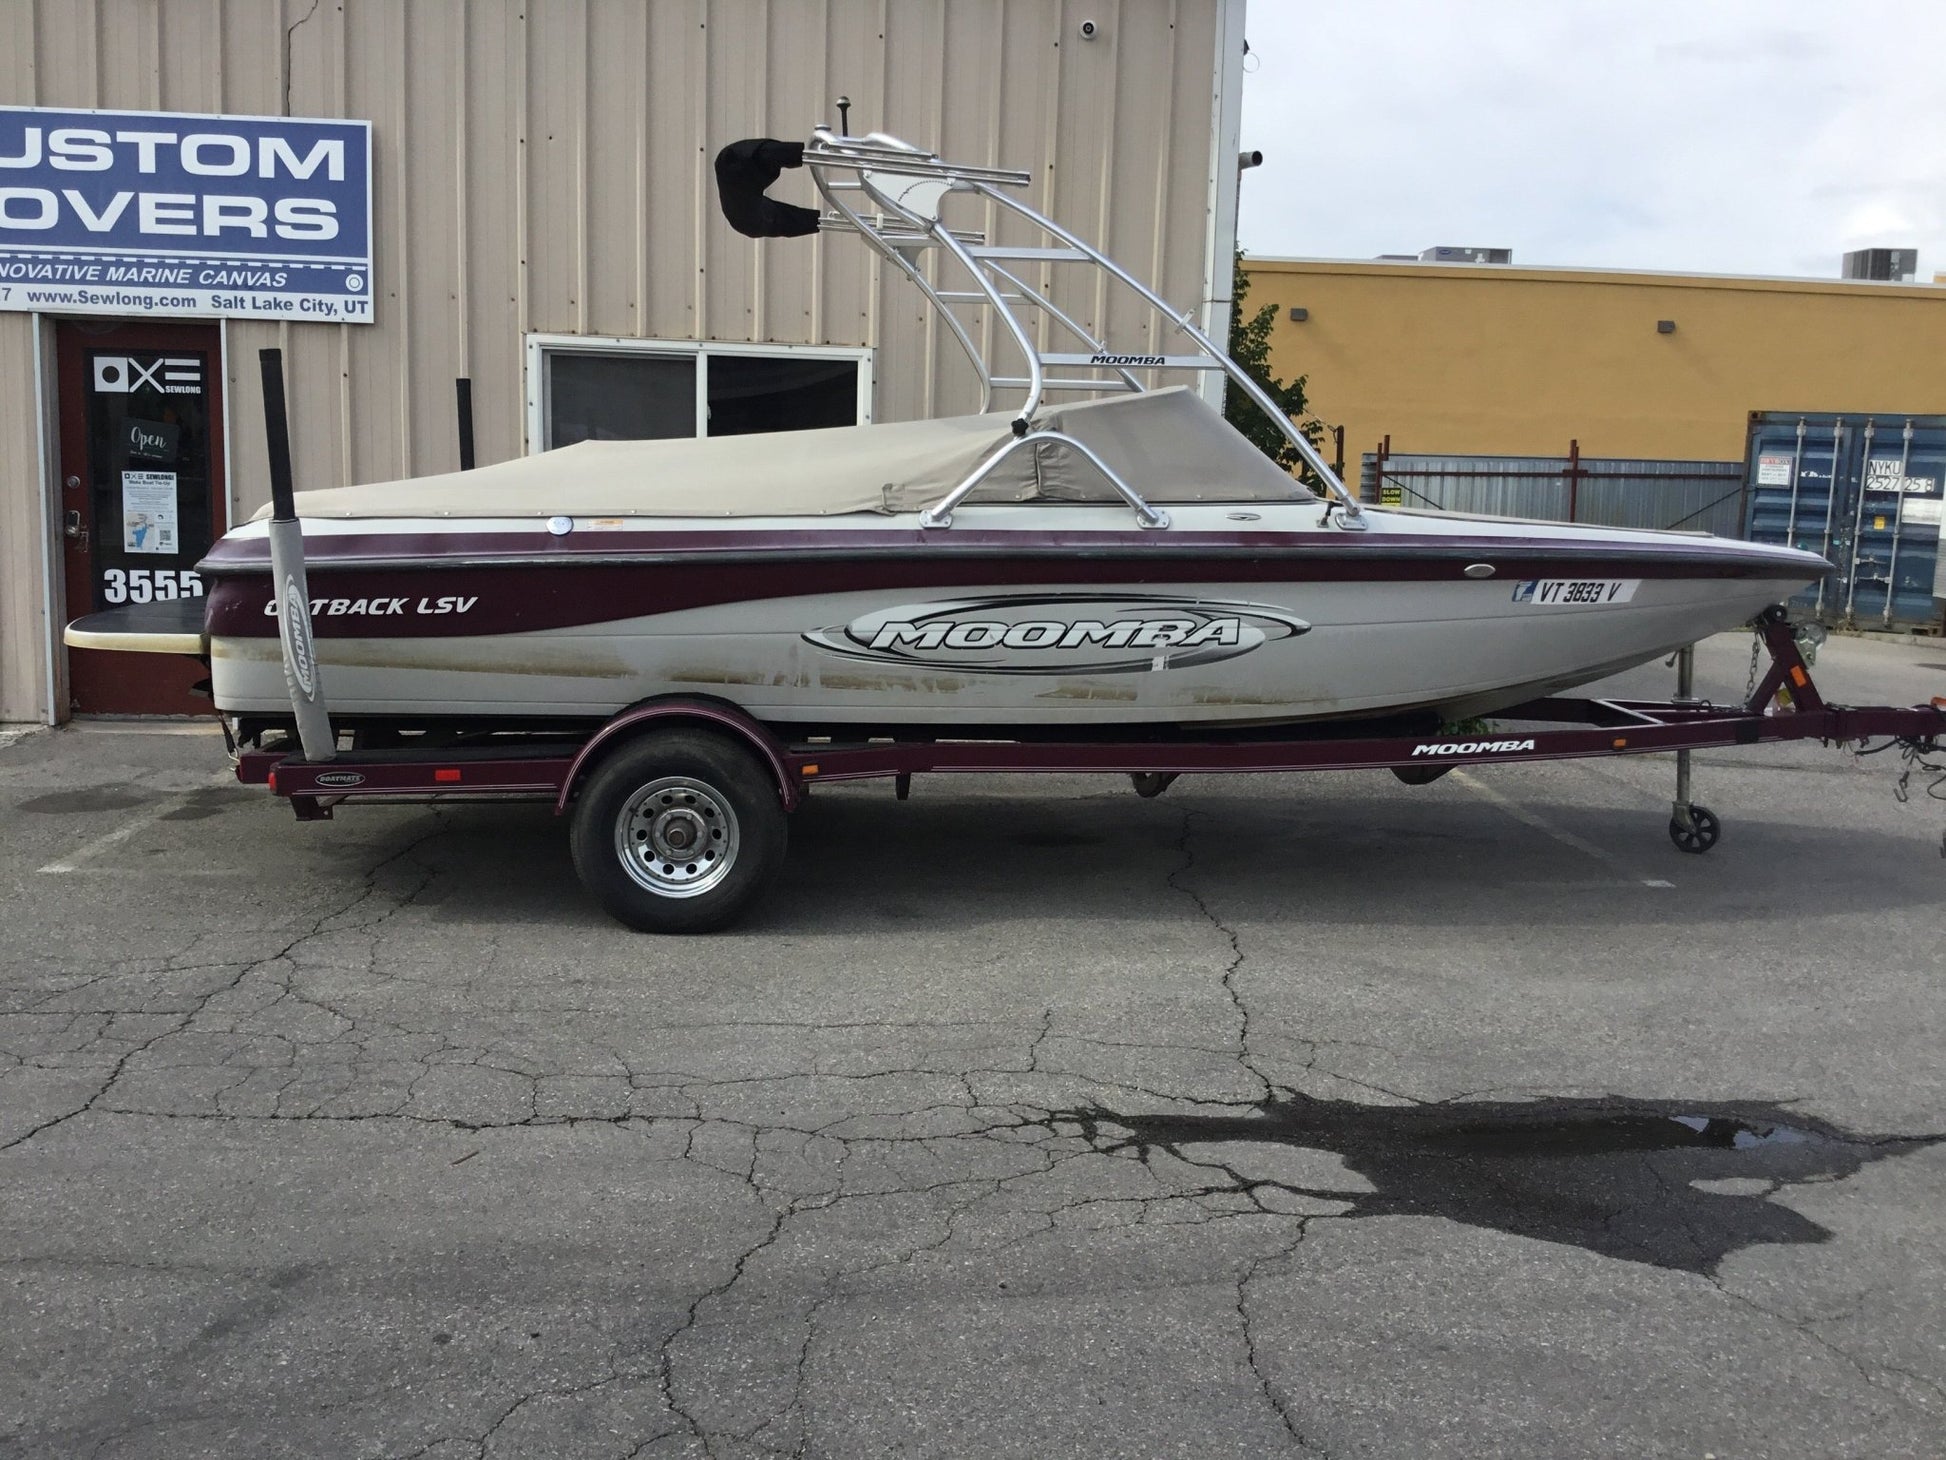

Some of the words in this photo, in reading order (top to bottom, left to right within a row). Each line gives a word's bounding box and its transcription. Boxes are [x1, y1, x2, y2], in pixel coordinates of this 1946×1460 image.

[0, 187, 339, 240] OVERS
[106, 267, 192, 284] MARINE
[199, 270, 288, 288] CANVAS
[27, 289, 197, 310] www.Sewlong.com
[211, 294, 246, 310] Salt
[252, 297, 293, 311] Lake
[300, 298, 338, 317] City,
[344, 300, 368, 314] UT
[1090, 355, 1165, 365] MOOMBA
[165, 385, 201, 394] SEWLONG
[131, 426, 167, 450] Open
[1868, 461, 1902, 475] NYKU
[104, 569, 203, 604] 3555
[1540, 582, 1565, 602] VT
[1563, 582, 1605, 603] 3833
[1607, 582, 1622, 602] V
[264, 597, 409, 616] OTBACK
[417, 597, 479, 614] LSV
[288, 593, 312, 691] MOOMBA
[868, 617, 1241, 650] MOOMBA
[1411, 739, 1535, 756] MOOMBA
